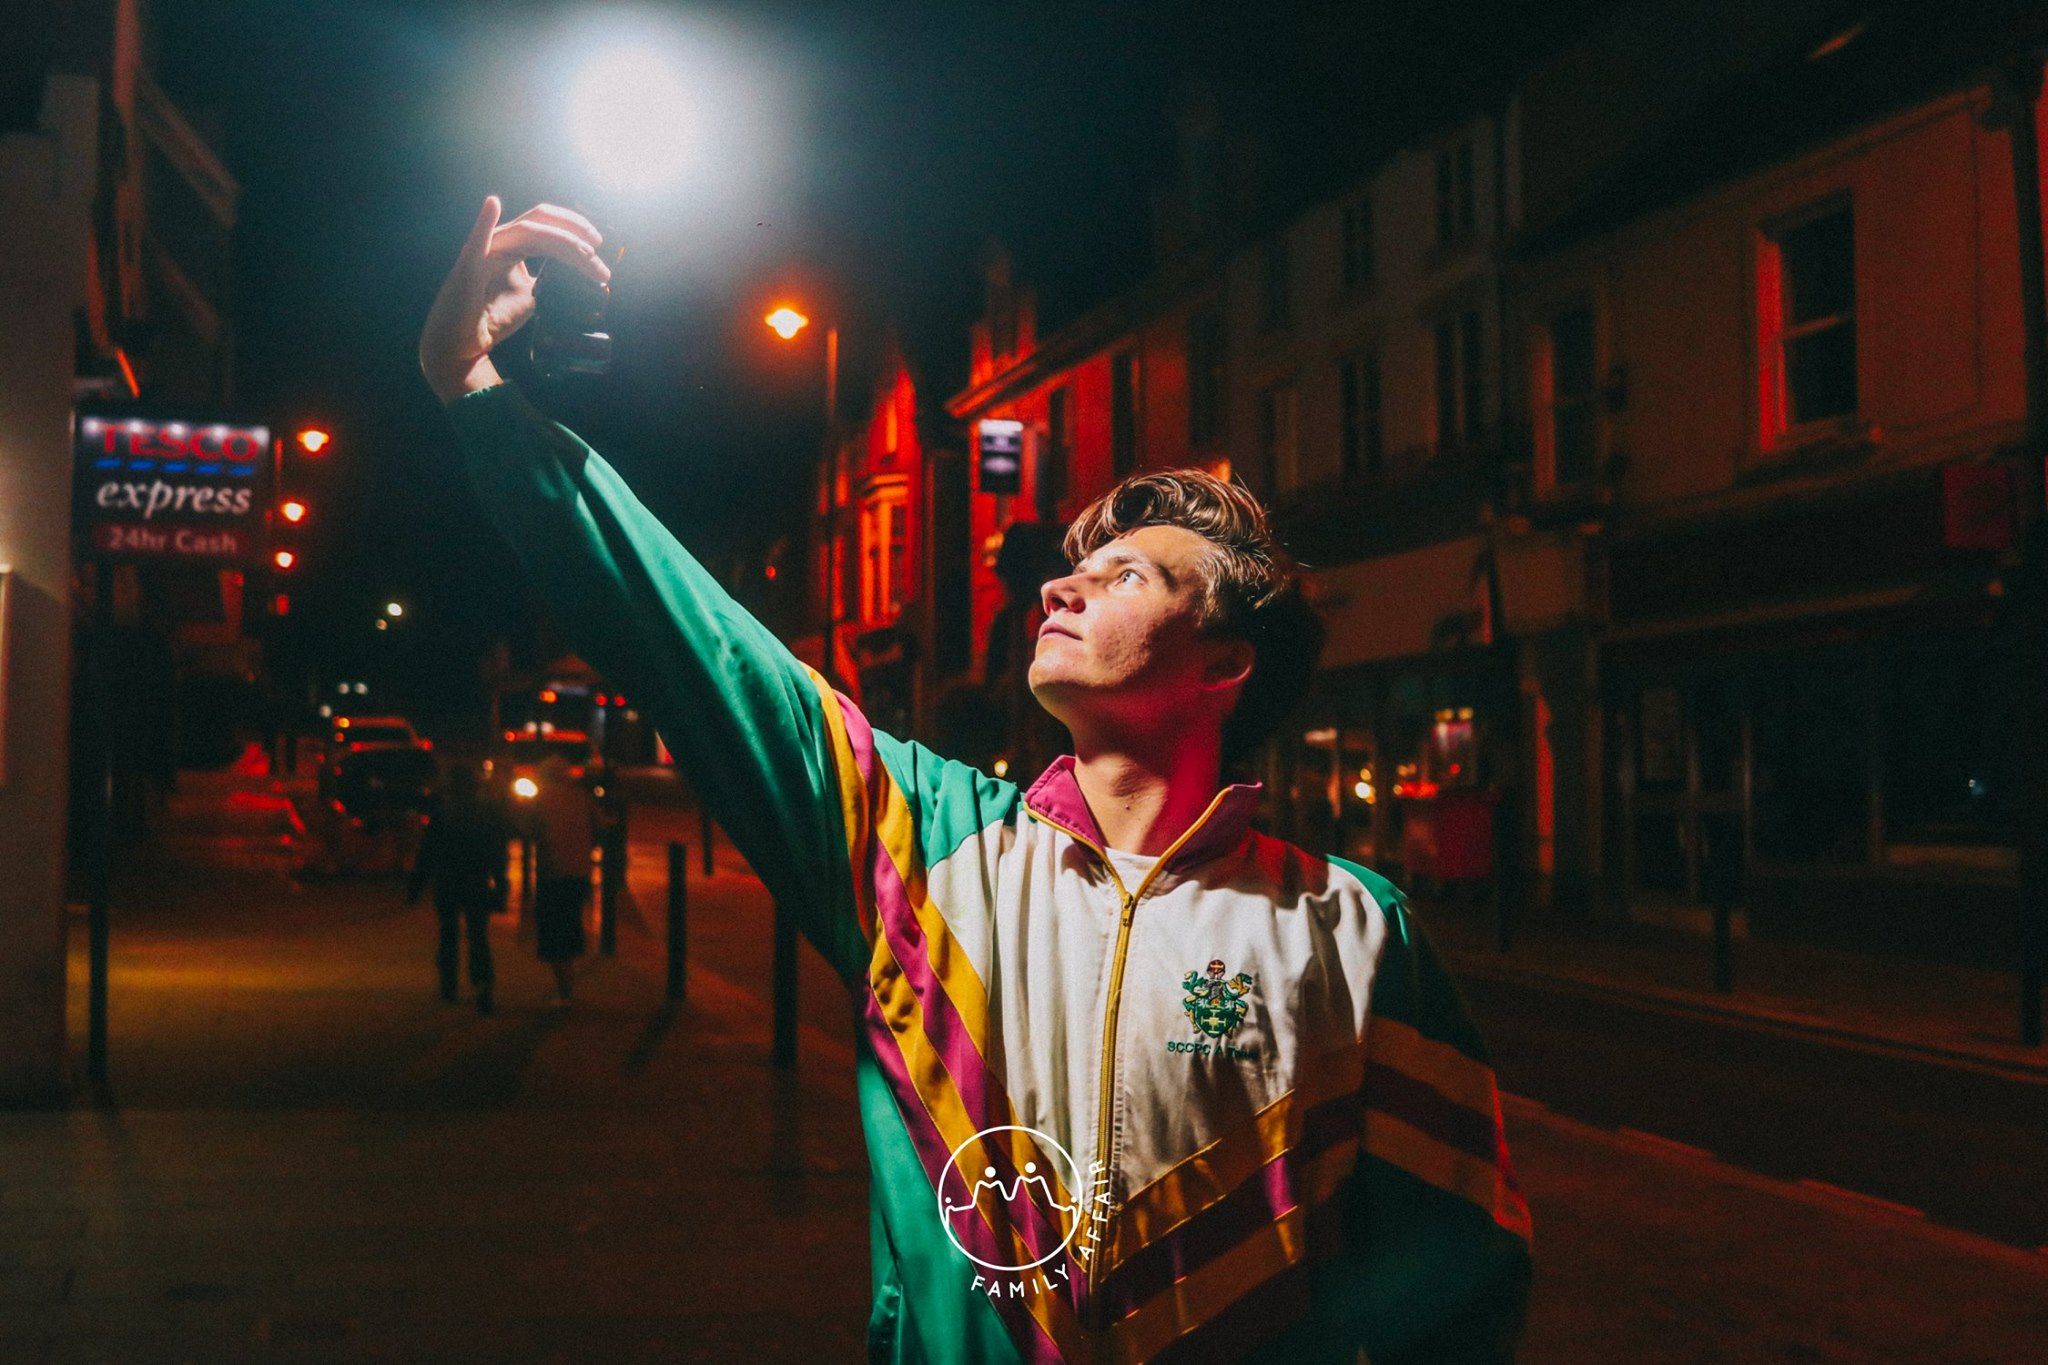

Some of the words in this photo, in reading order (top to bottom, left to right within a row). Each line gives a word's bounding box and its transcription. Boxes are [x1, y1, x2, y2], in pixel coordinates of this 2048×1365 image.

[98, 422, 260, 462] TESCO
[96, 480, 253, 520] express
[107, 525, 168, 551] 24hr
[174, 528, 239, 554] Cash
